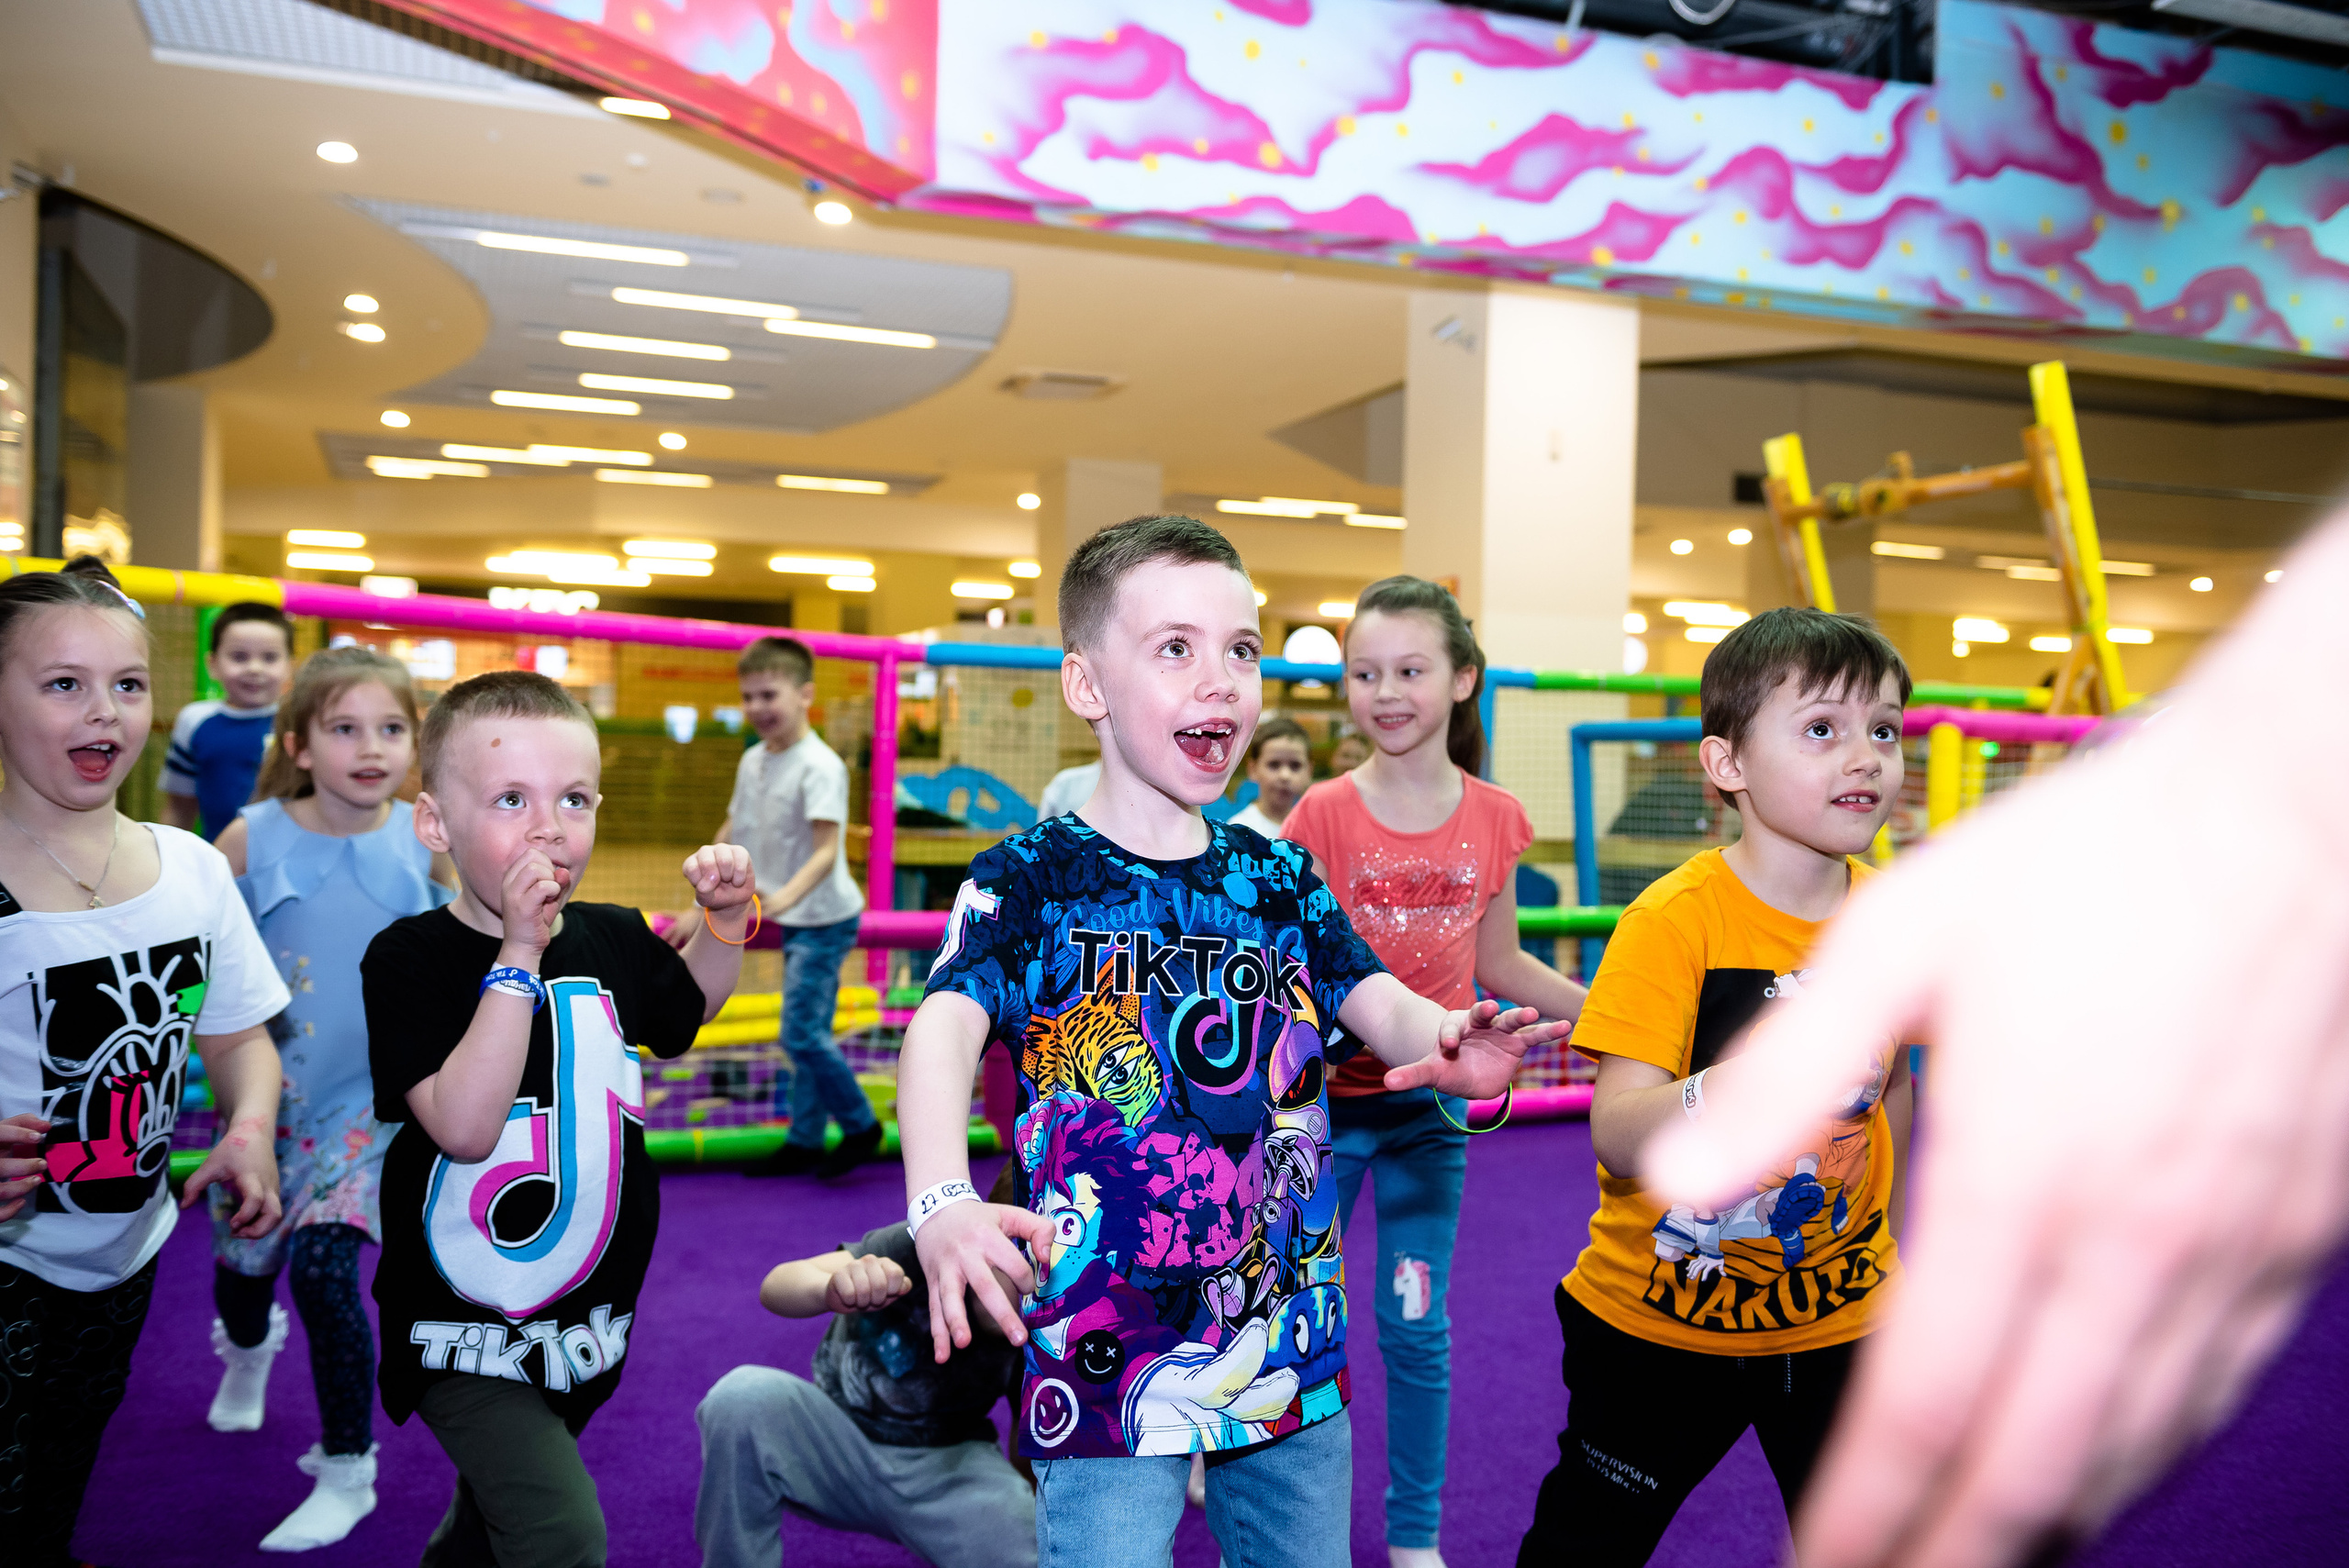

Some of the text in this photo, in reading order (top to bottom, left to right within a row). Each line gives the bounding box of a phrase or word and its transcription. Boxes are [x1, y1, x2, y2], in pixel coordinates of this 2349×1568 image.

[1172, 886, 1267, 940] Vibes
[1069, 929, 1308, 1012] TikTok
[410, 1303, 633, 1393] TikTok
